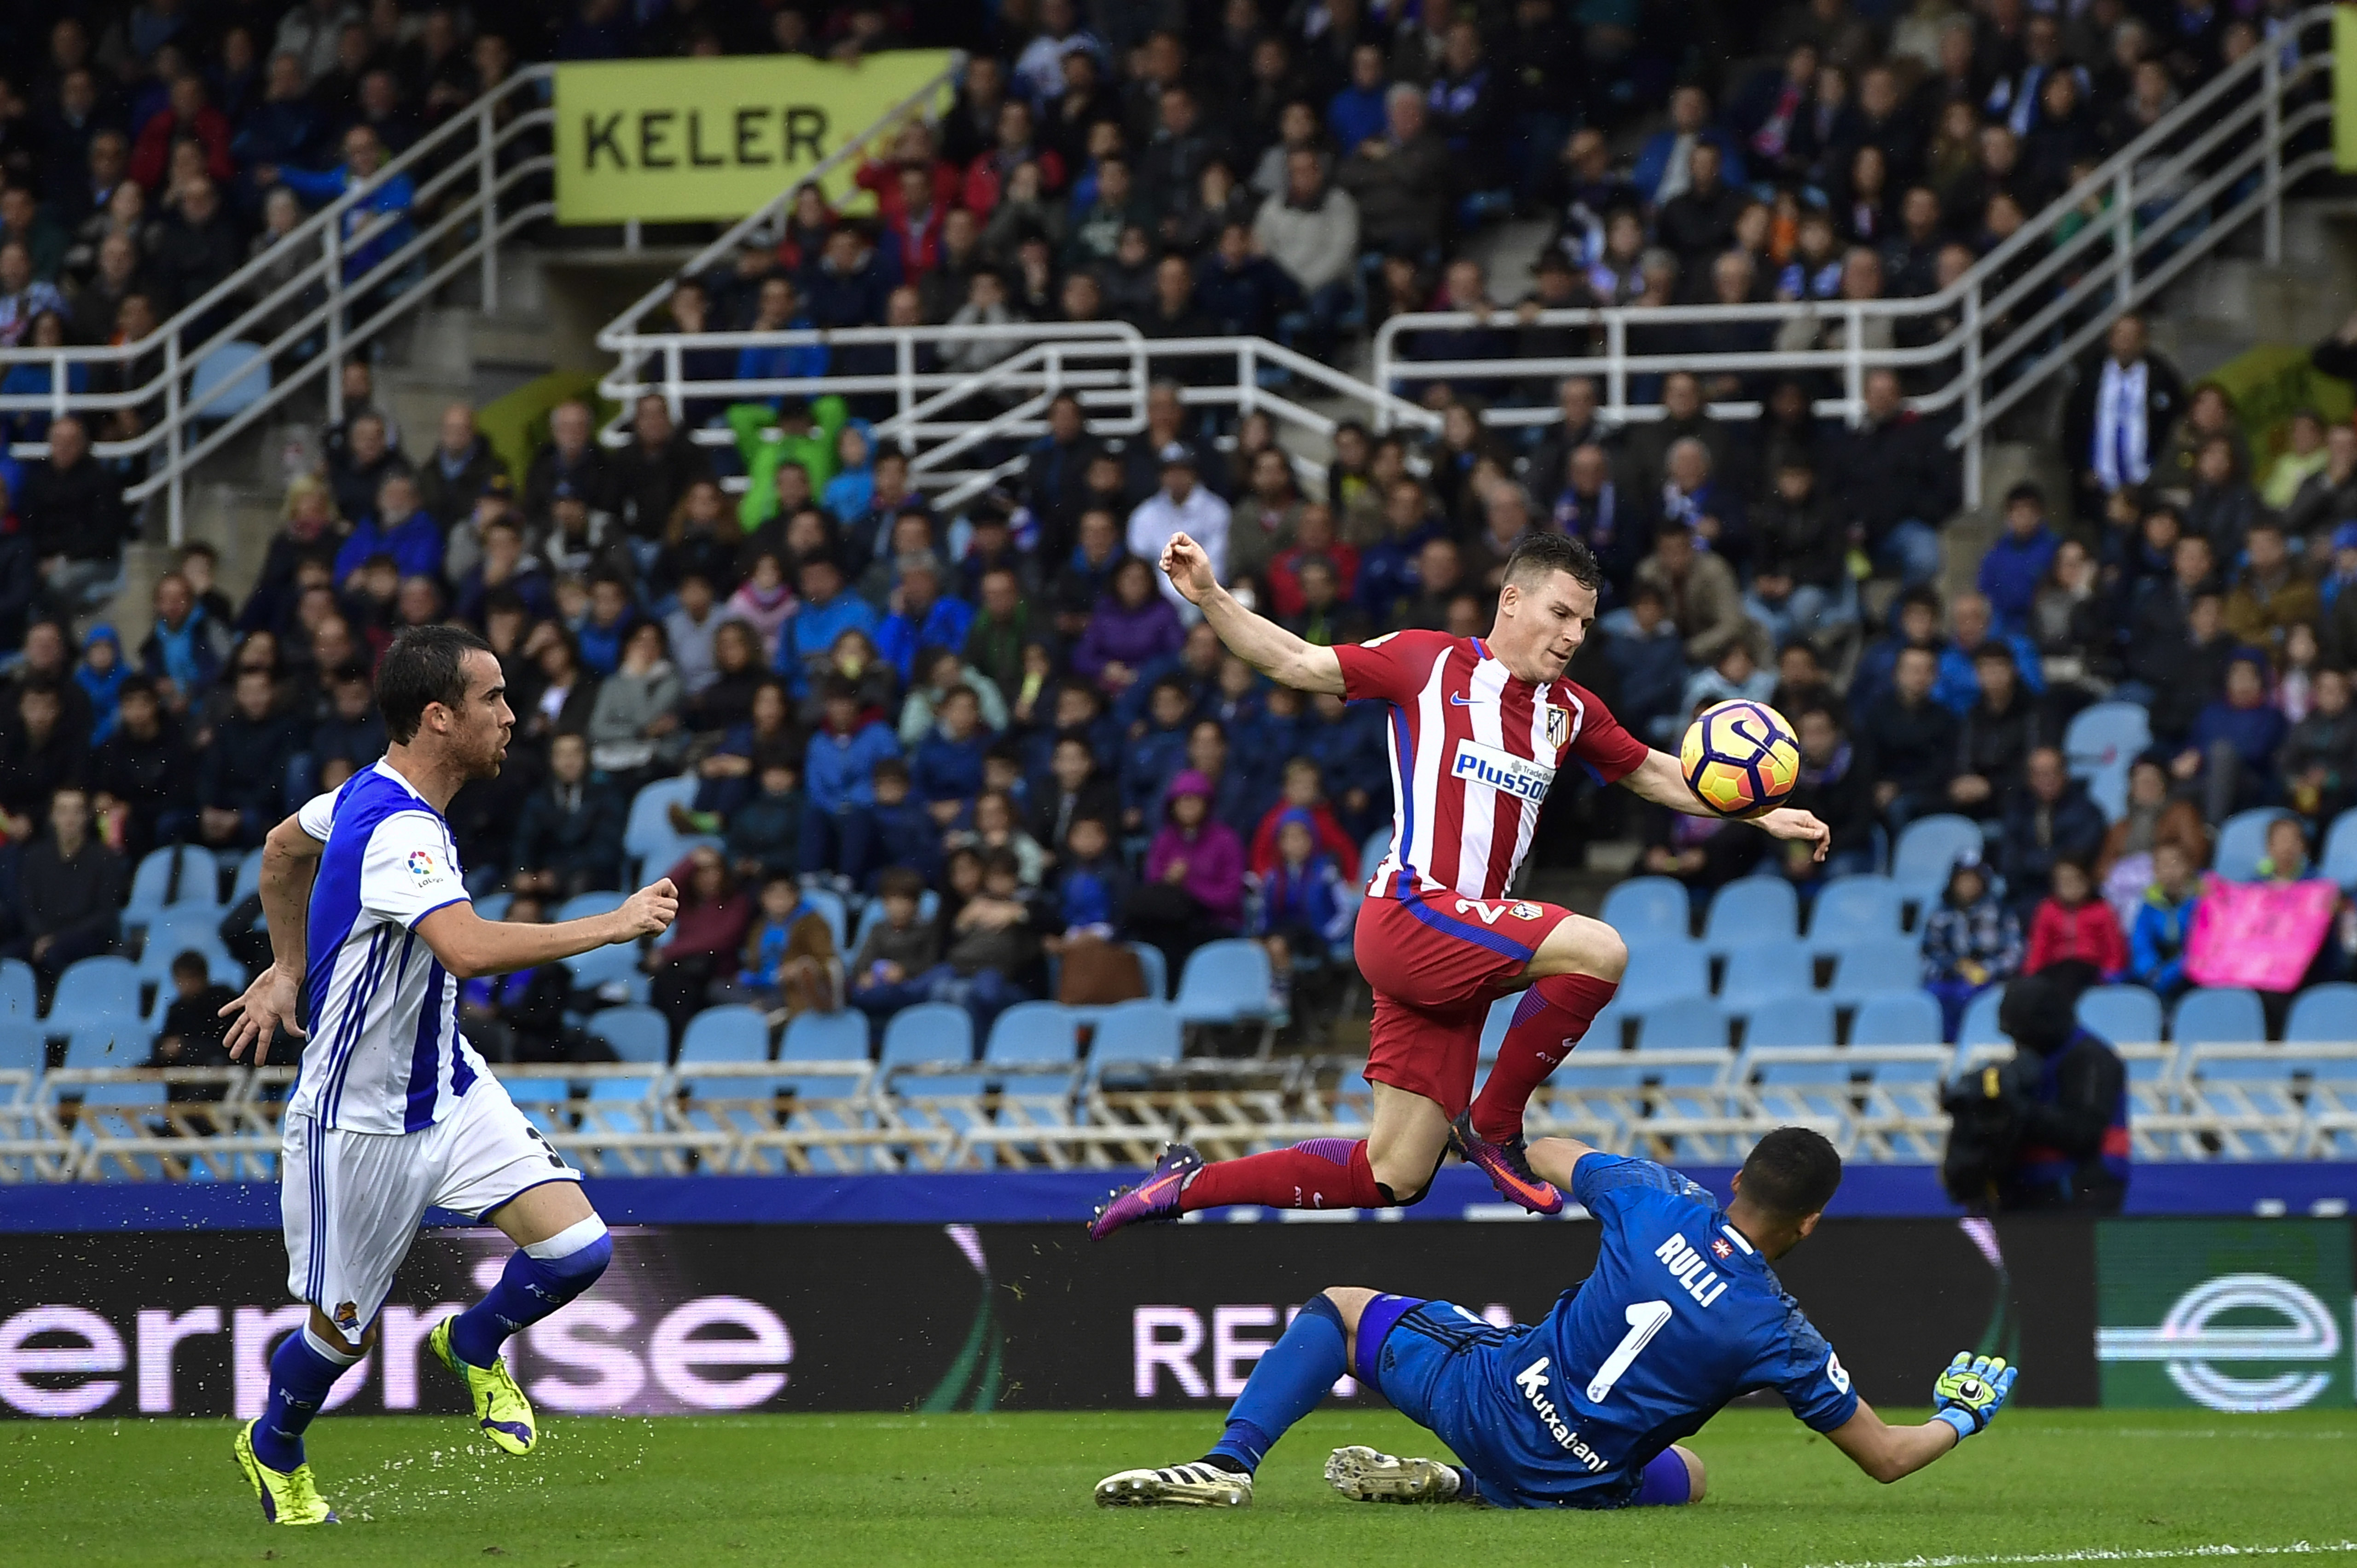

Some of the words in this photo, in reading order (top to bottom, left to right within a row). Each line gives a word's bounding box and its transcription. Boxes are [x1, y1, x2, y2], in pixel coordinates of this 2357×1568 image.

[582, 104, 828, 173] KELER
[1523, 765, 1542, 779] Trade
[1655, 1232, 1728, 1308] RULLI
[1586, 1300, 1672, 1403] 1
